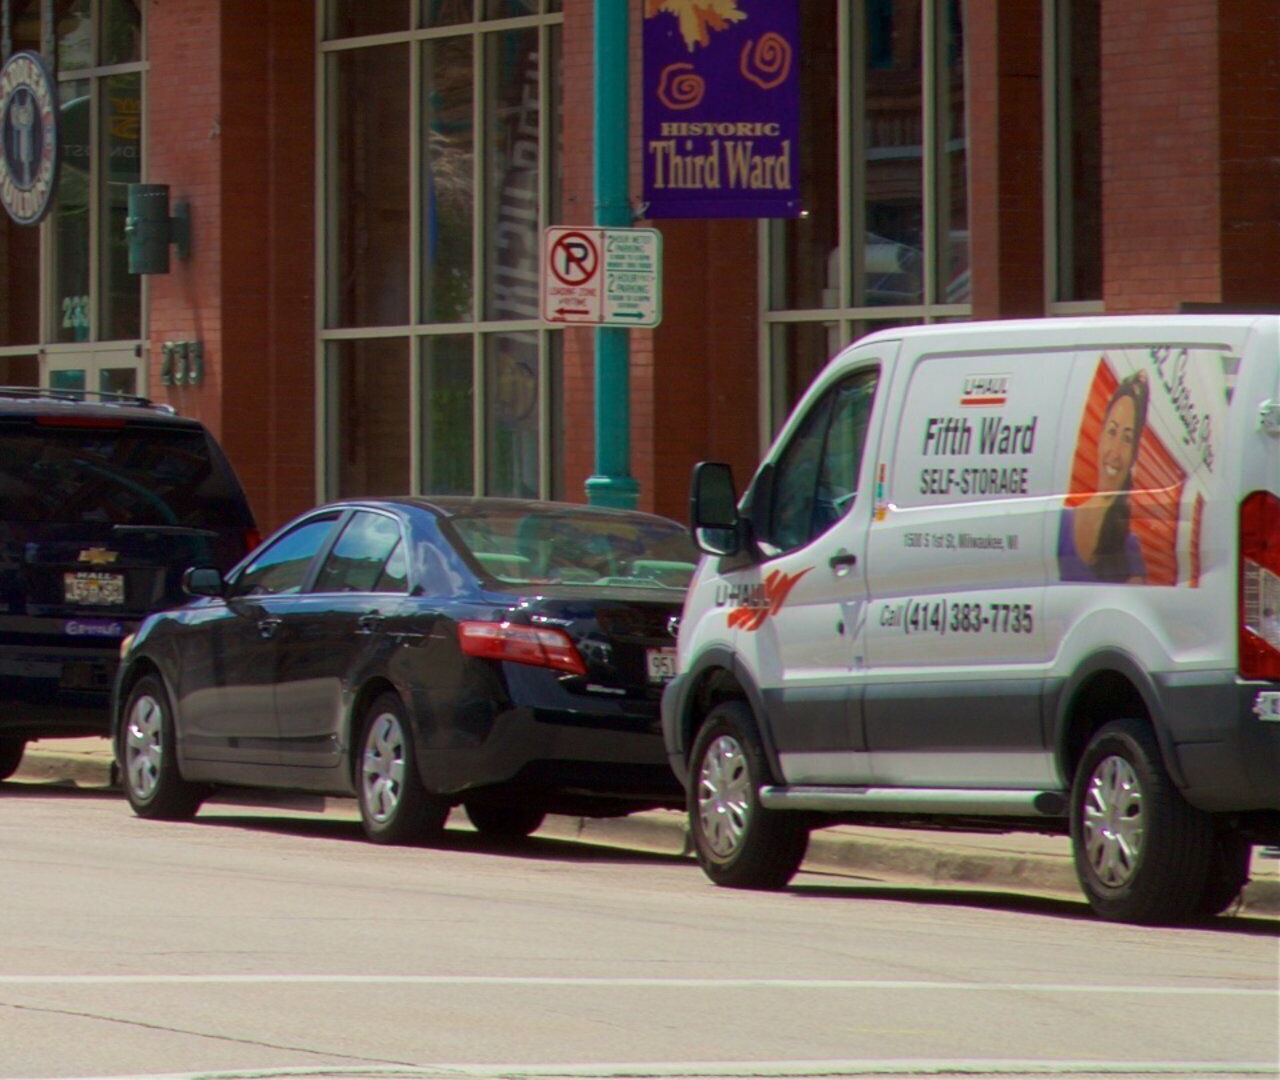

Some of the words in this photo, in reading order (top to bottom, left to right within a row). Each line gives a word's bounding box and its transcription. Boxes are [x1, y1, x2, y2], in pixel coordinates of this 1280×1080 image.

[660, 121, 782, 137] HISTORIC
[649, 138, 722, 190] Third
[724, 138, 793, 190] Ward
[922, 416, 973, 457] Fifth
[979, 415, 1038, 456] Ward
[919, 468, 1029, 496] SELF-STORAGE
[880, 603, 903, 627] Call
[904, 598, 947, 635] (414)
[949, 602, 1034, 634] 383-7735
